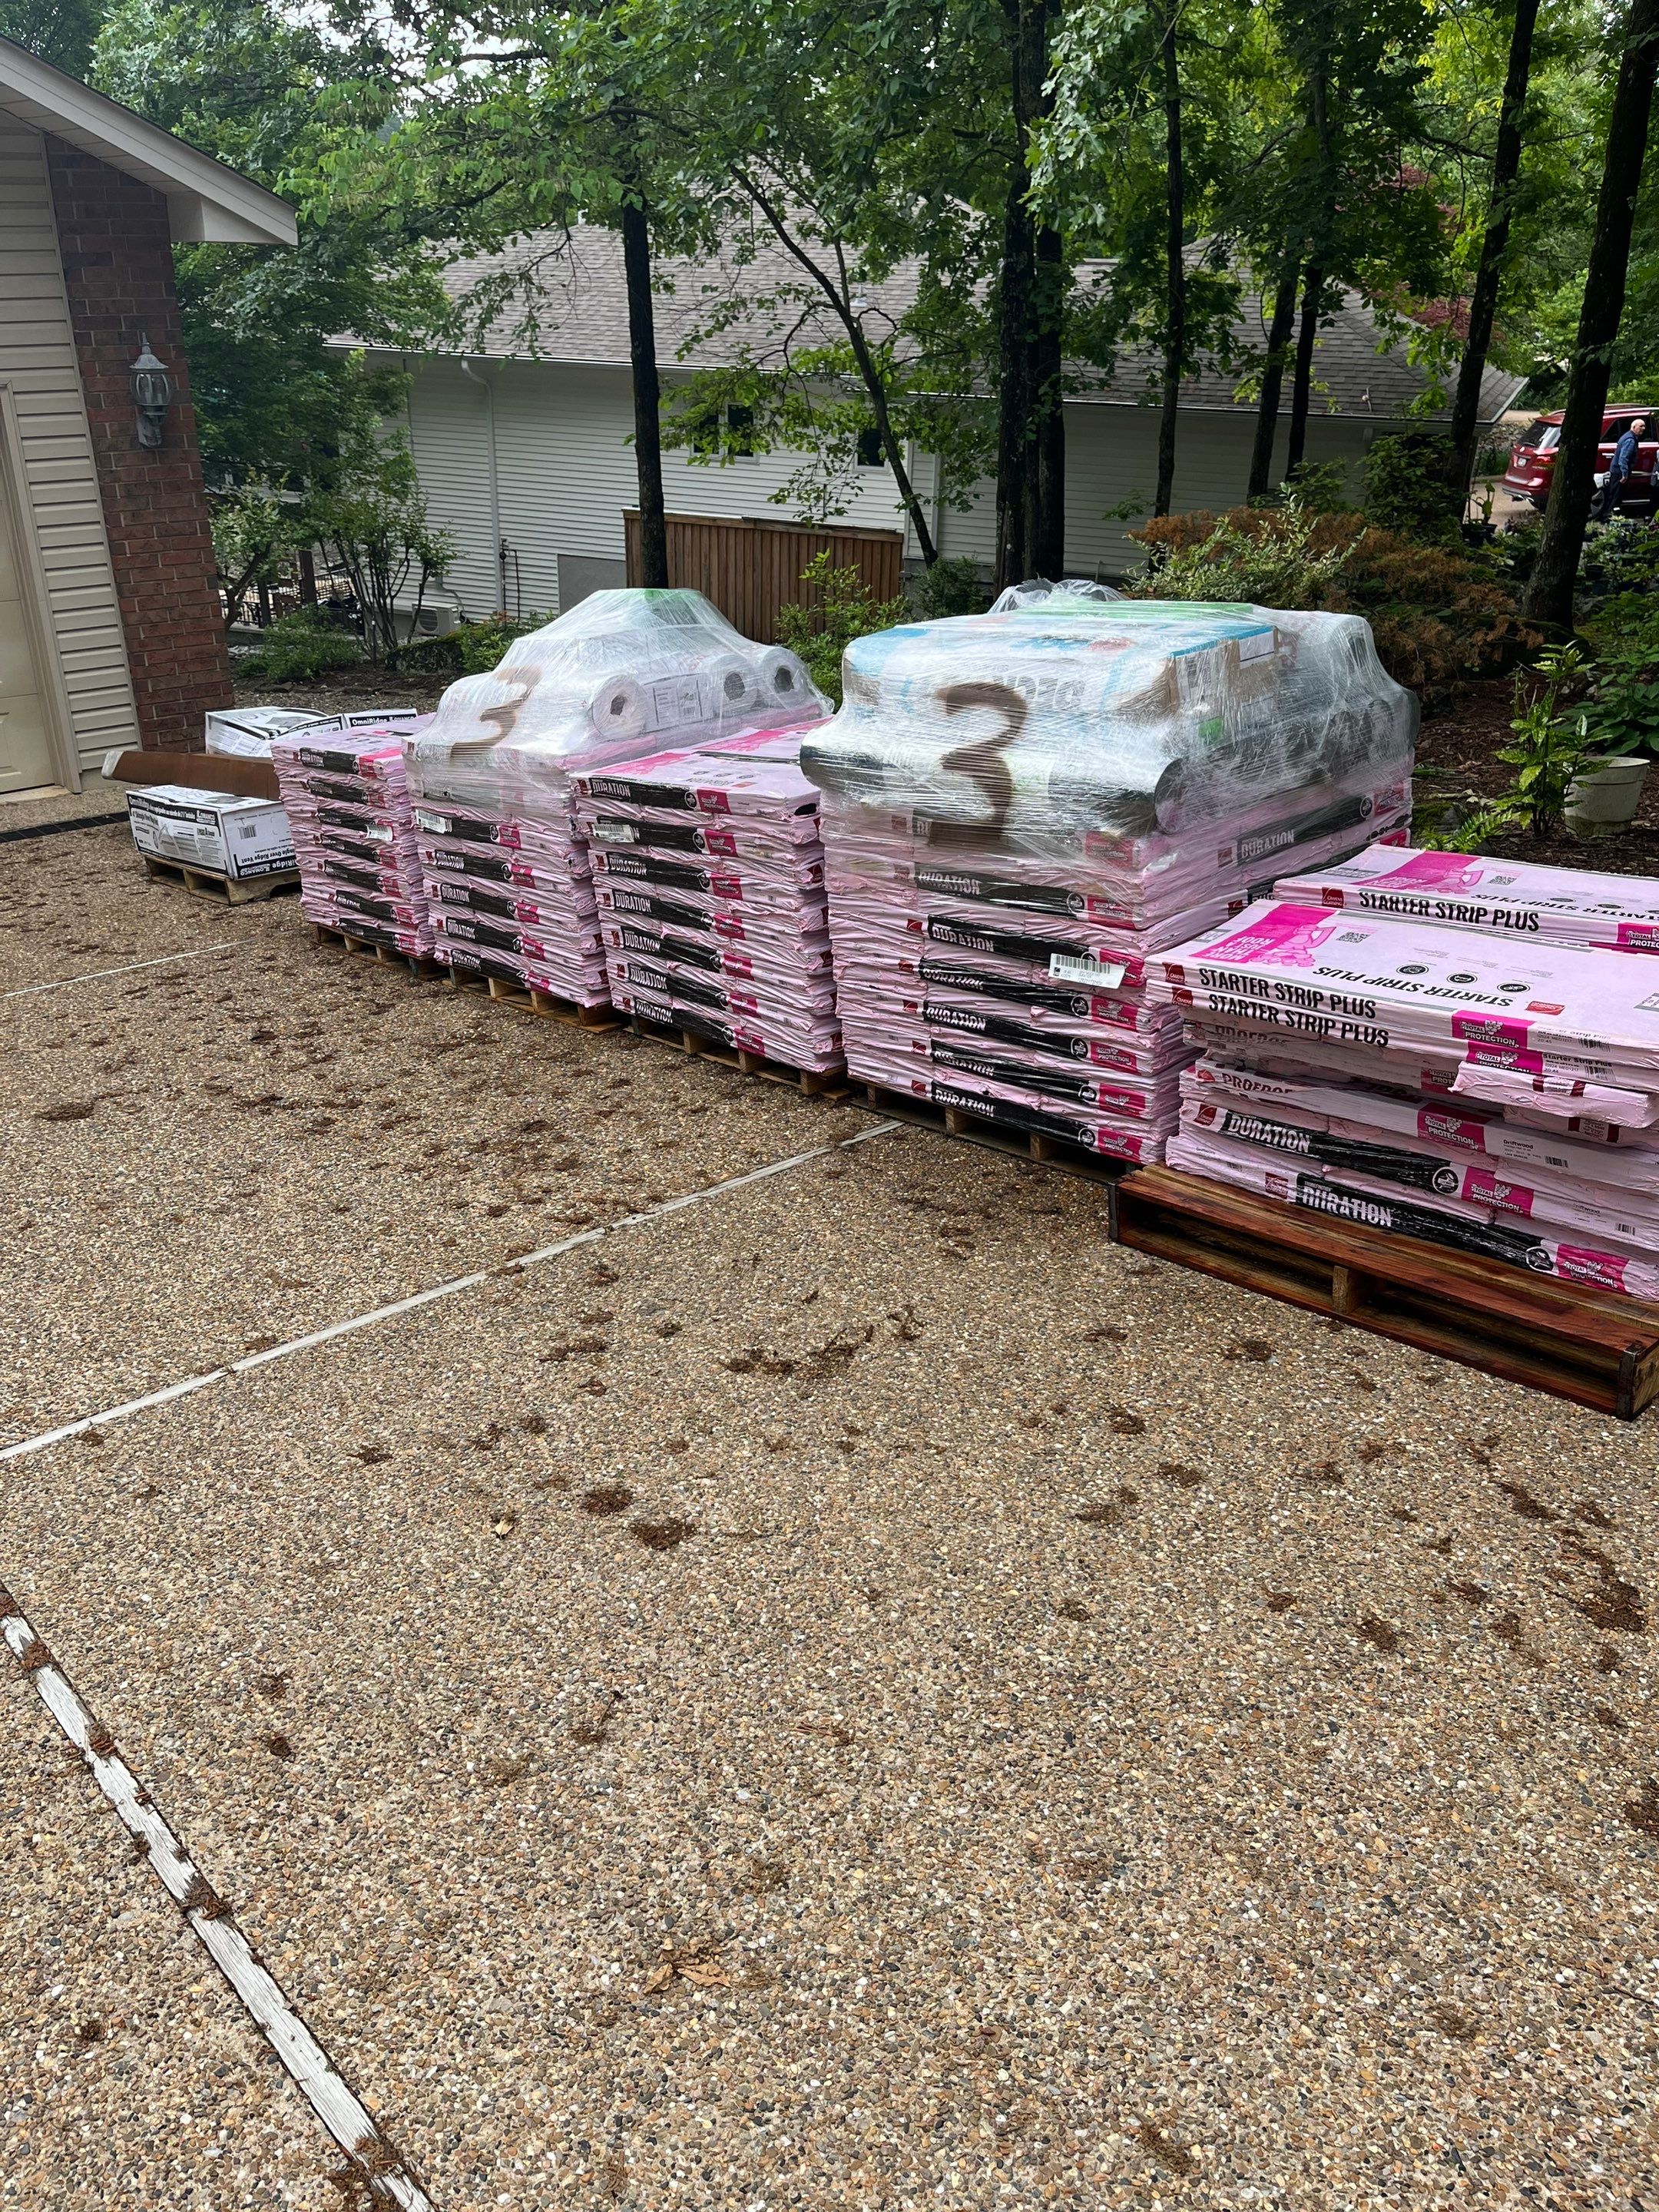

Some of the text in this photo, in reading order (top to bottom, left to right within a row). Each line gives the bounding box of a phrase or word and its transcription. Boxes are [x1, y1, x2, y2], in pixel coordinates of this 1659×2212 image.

[450, 665, 545, 759] 3
[928, 681, 1028, 845] 3
[592, 782, 631, 797] DURATION
[282, 847, 295, 856] ingle
[1241, 829, 1295, 859] DURATION
[272, 859, 296, 869] iRidge
[609, 857, 647, 876] DURATION
[442, 886, 470, 903] DURATION
[615, 895, 652, 913] DURATION
[1359, 891, 1540, 932] STARTER STRIP PLUS
[448, 921, 475, 939] DURATION
[932, 926, 995, 952] DURATION
[624, 935, 661, 952] DURATION
[630, 969, 668, 990] DURATION
[1312, 966, 1366, 982] PLUS
[1363, 976, 1425, 993] STRIP
[1423, 986, 1514, 1007] STARTER
[1199, 968, 1377, 1019] STARTER STRIP PLUS
[926, 1006, 987, 1031] DURATION
[1209, 994, 1390, 1048] STARTER STRIP PLUS
[1465, 1031, 1515, 1045] PROTECTION
[1543, 1054, 1572, 1062] Starter
[1573, 1057, 1593, 1065] Strip
[935, 1089, 995, 1117] DURATION
[1228, 1114, 1311, 1153] DURATION
[1428, 1127, 1475, 1145] PROTECTION
[1503, 1139, 1534, 1149] Driftwood
[1475, 1187, 1492, 1196] TOTAL
[1303, 1186, 1392, 1227] DURATION
[1472, 1194, 1520, 1211] PROTECTION
[1568, 1263, 1587, 1273] TOTAL
[1570, 1271, 1614, 1285] PROTECTION
